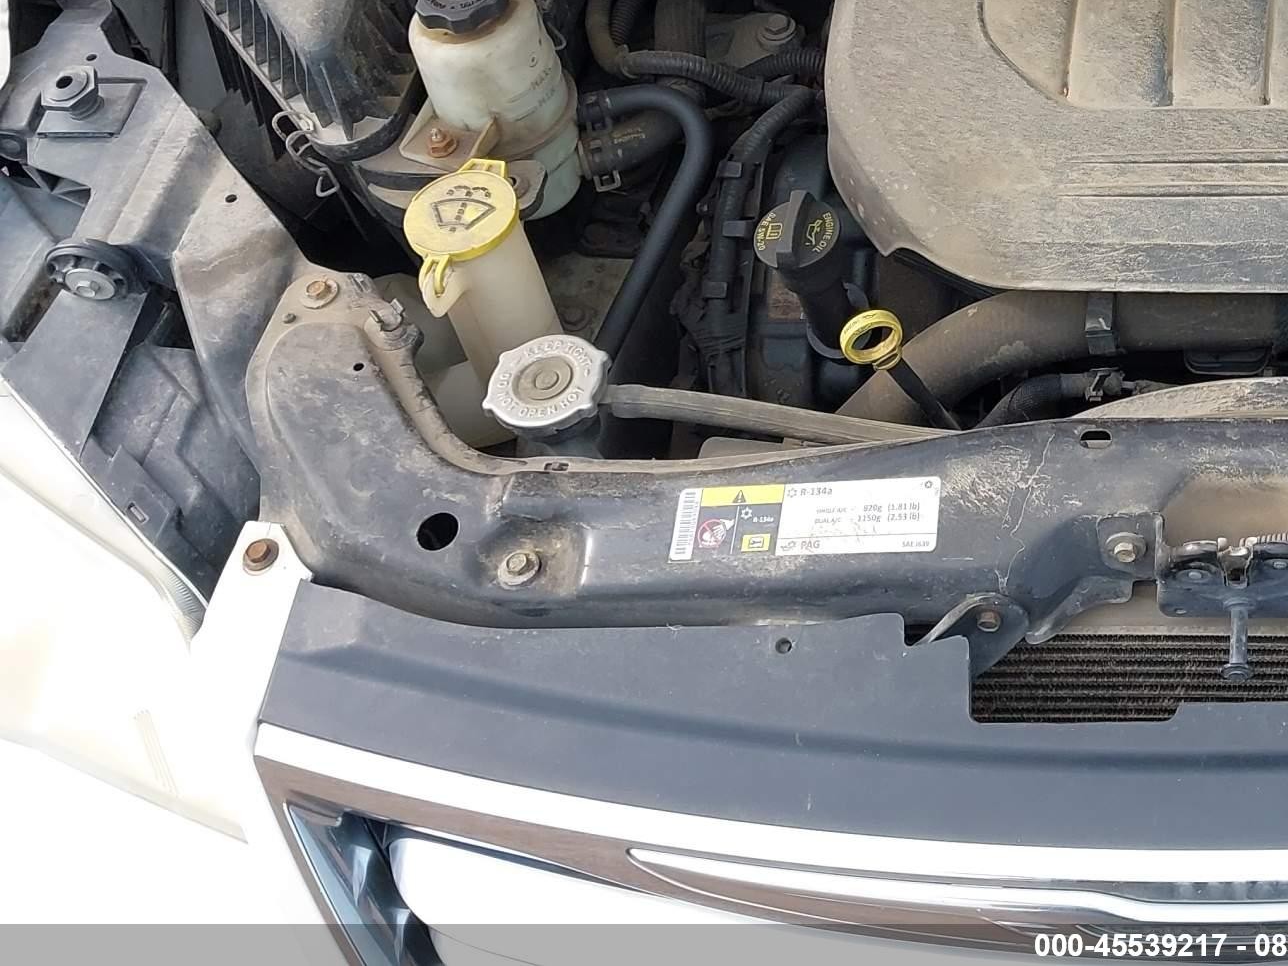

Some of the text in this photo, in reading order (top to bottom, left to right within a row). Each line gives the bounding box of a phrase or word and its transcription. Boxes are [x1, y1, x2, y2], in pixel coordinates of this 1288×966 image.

[811, 212, 834, 253] ENGINE OIL
[526, 340, 592, 366] KEEP TIGHT
[497, 373, 585, 419] DO NOT OPEN HOT
[800, 487, 833, 497] R-134a
[887, 502, 908, 512] (1.81
[909, 502, 920, 511] lb)
[909, 513, 920, 522] lb)
[800, 540, 820, 550] PAG
